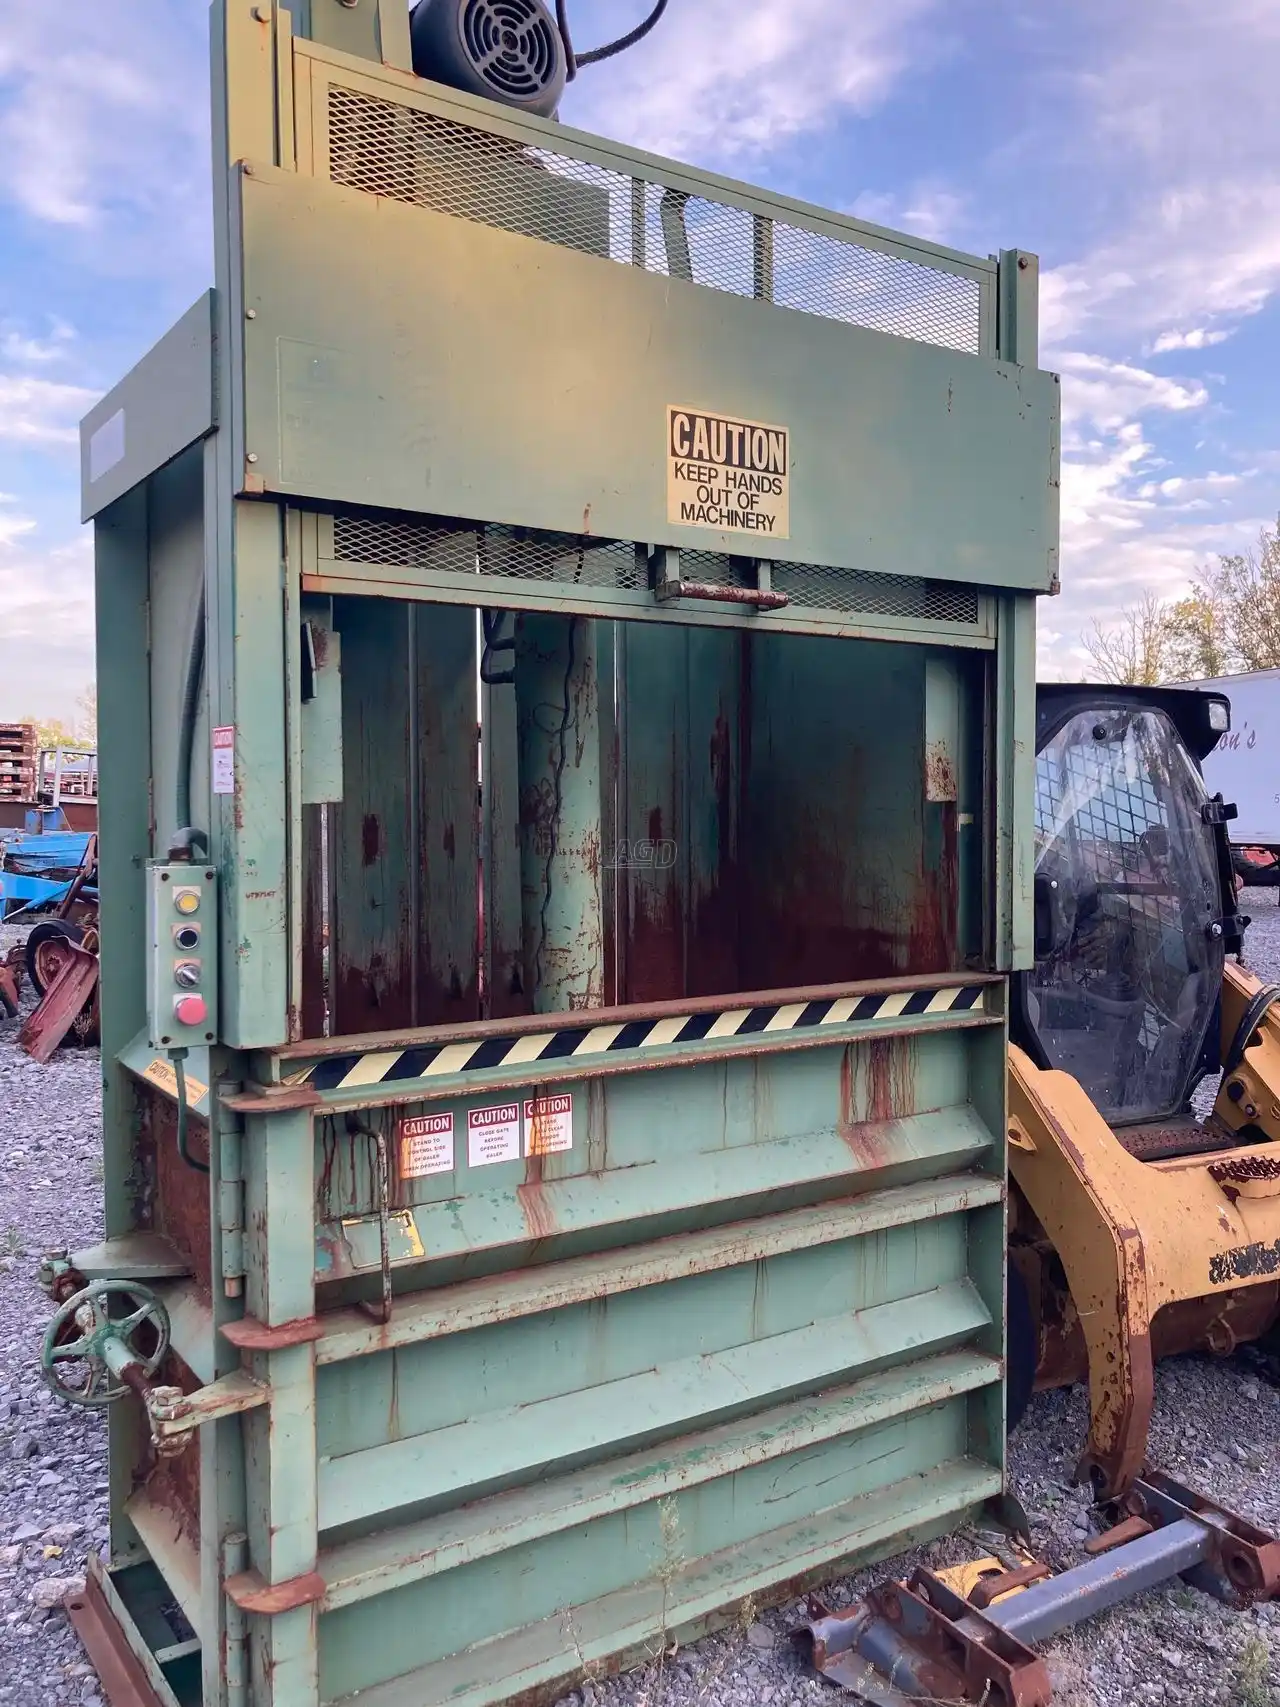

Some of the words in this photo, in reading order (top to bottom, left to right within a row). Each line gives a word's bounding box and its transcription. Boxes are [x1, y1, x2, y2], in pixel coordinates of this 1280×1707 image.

[673, 413, 786, 475] CAUTION
[674, 461, 719, 485] KEEP
[725, 470, 783, 496] HANDS
[696, 484, 733, 508] OUT
[737, 491, 760, 511] OF
[680, 502, 776, 532] MACHINERY
[1212, 721, 1257, 752] on's
[404, 1116, 450, 1135] CAUTION
[472, 1107, 516, 1125] CAUTION
